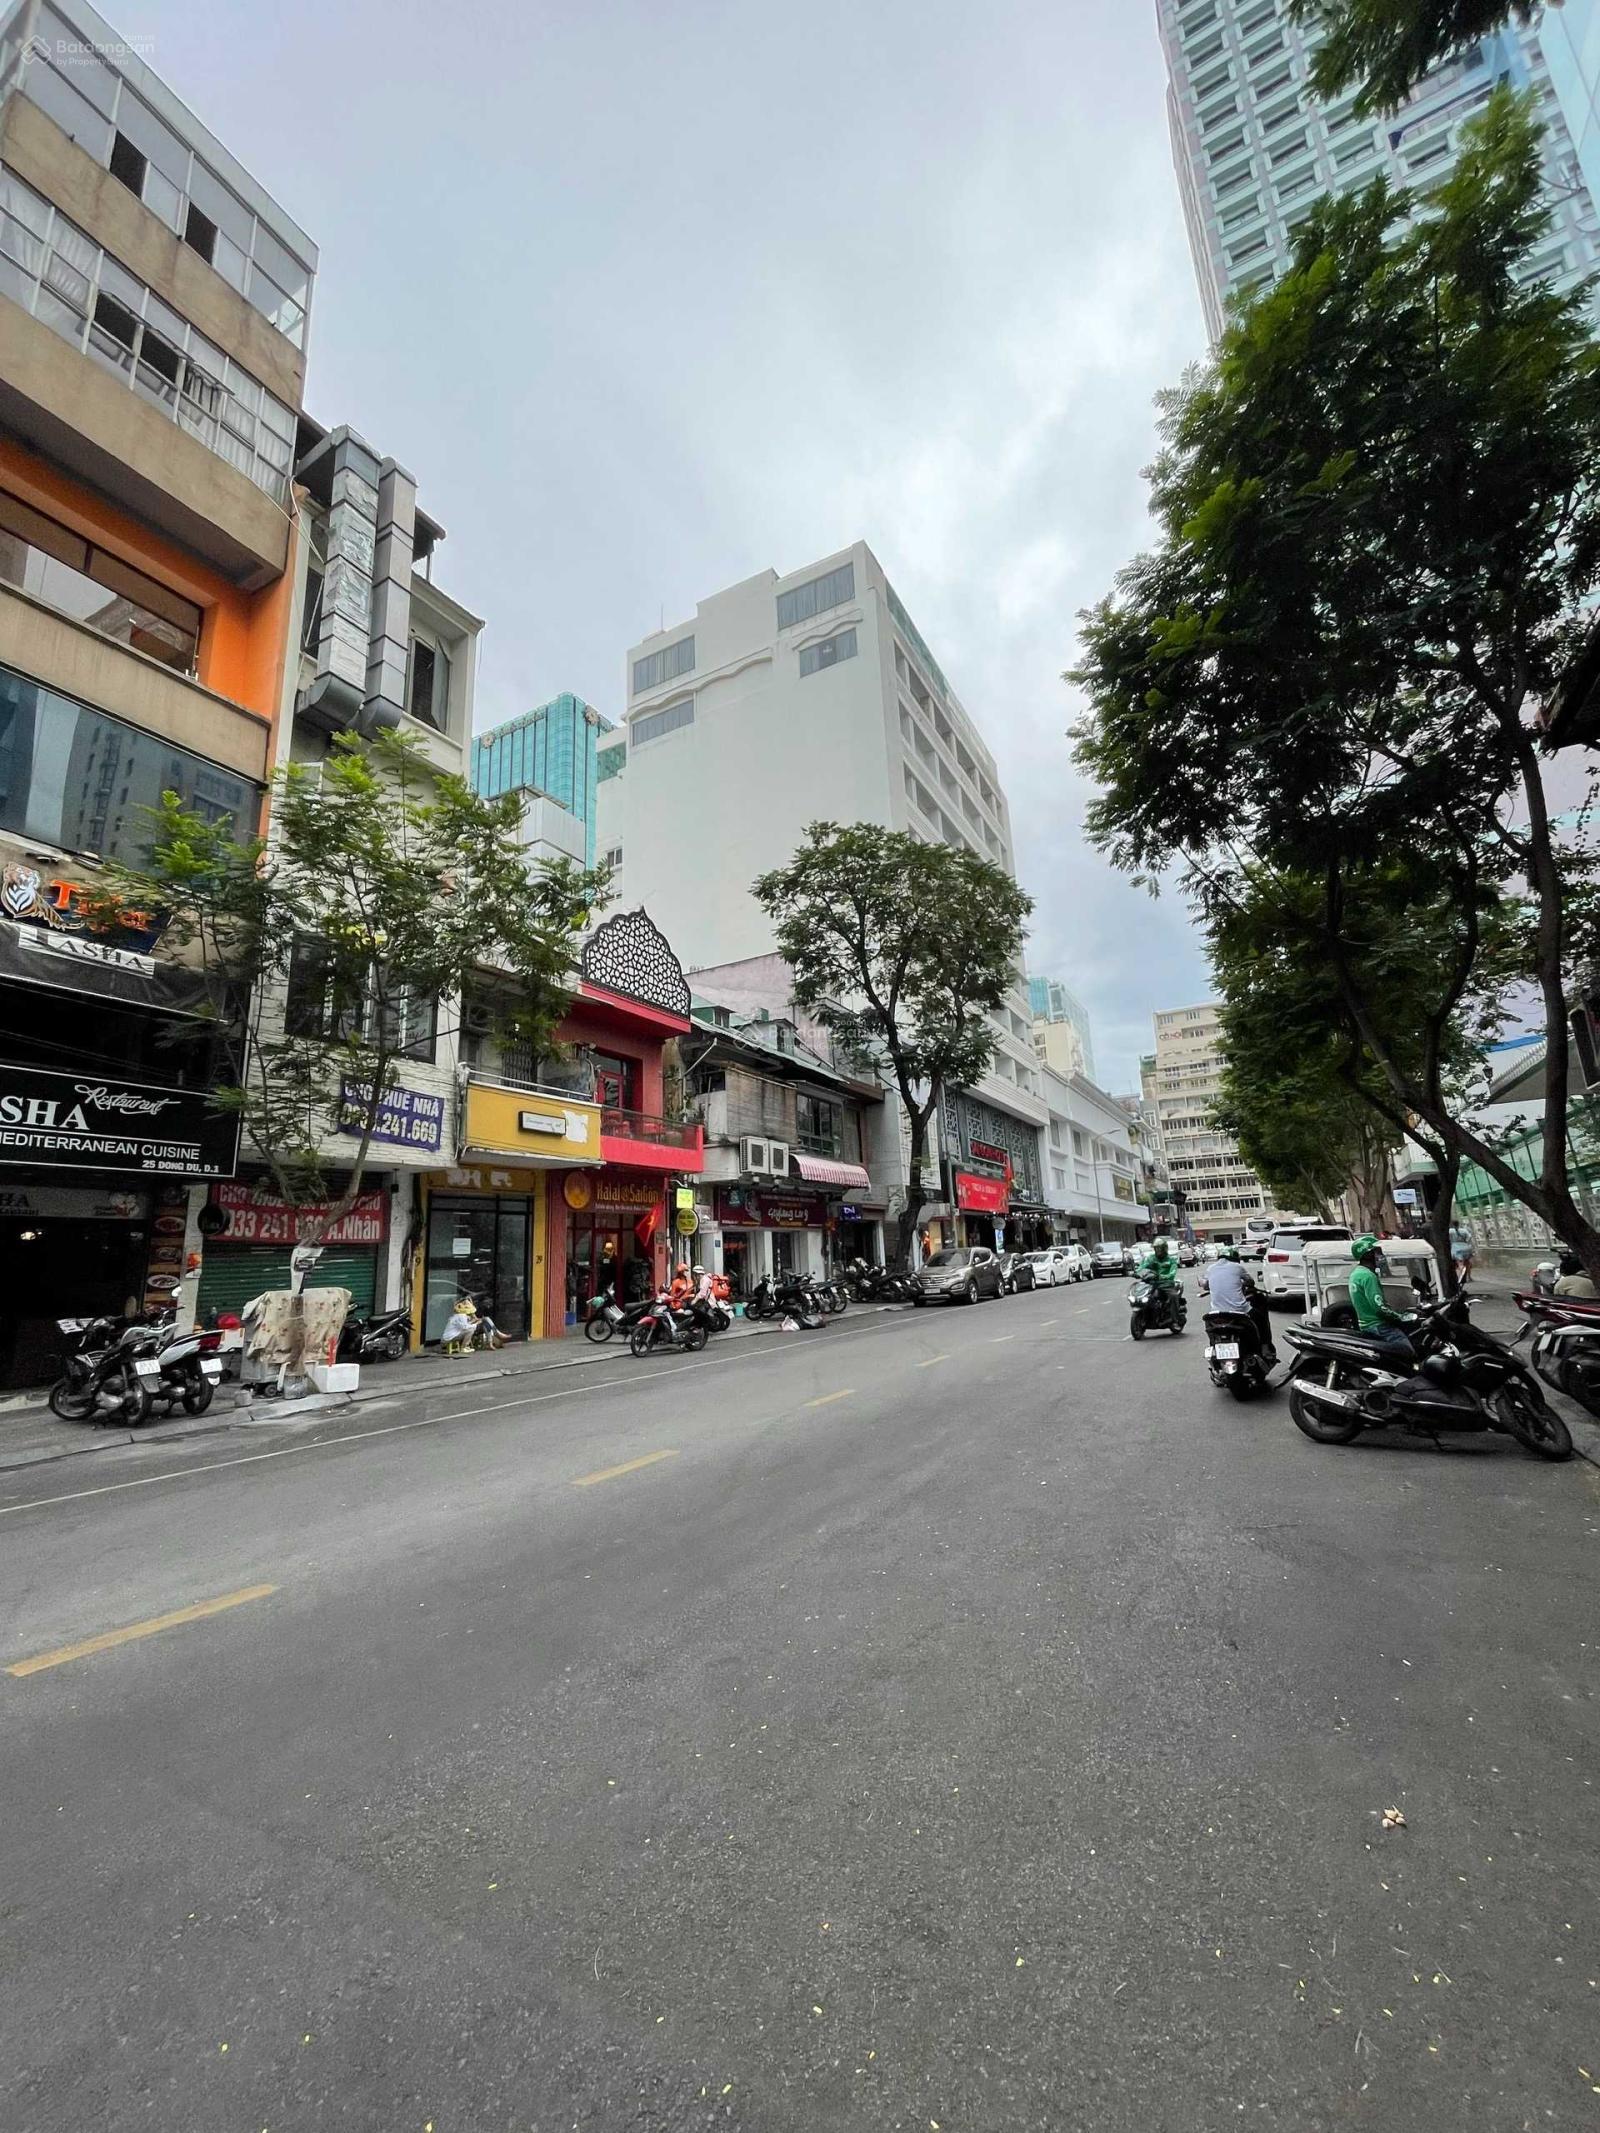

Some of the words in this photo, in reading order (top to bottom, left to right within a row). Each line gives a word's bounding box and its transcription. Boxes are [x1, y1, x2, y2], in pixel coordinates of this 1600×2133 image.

[74, 1084, 182, 1115] Restaurant
[0, 1131, 137, 1155] EDITERRANEAN
[141, 1144, 200, 1160] CUISINE
[142, 1160, 156, 1169] 25
[158, 1161, 184, 1171] DONG
[327, 1214, 380, 1240] A.Nhân
